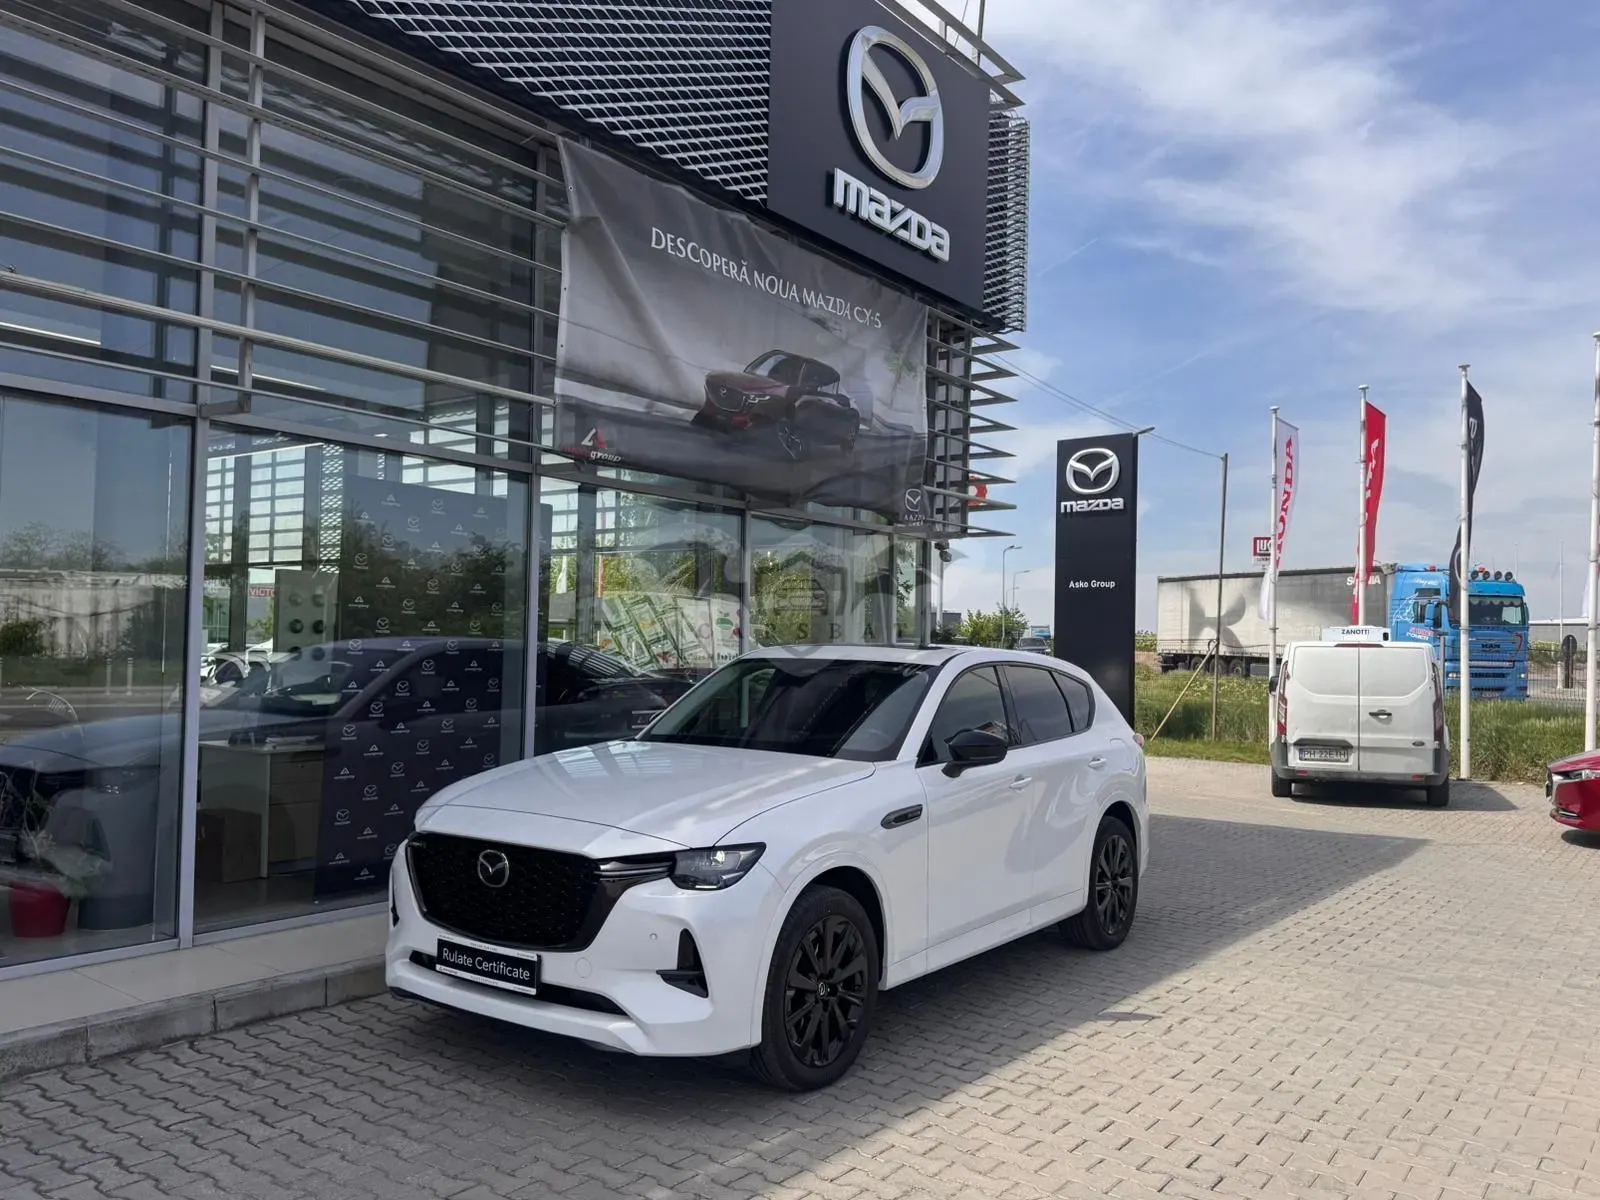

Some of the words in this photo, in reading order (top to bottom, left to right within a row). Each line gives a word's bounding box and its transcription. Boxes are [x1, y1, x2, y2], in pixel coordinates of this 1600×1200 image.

[833, 167, 950, 262] mazda
[651, 227, 751, 286] DESCOPERĂ
[753, 270, 799, 303] NOUA
[802, 288, 851, 320] MAZDA
[1060, 497, 1124, 513] mazda
[1069, 580, 1089, 588] Asko
[1091, 580, 1115, 589] Group
[442, 947, 473, 967] Rulate
[474, 956, 531, 980] Certificate
